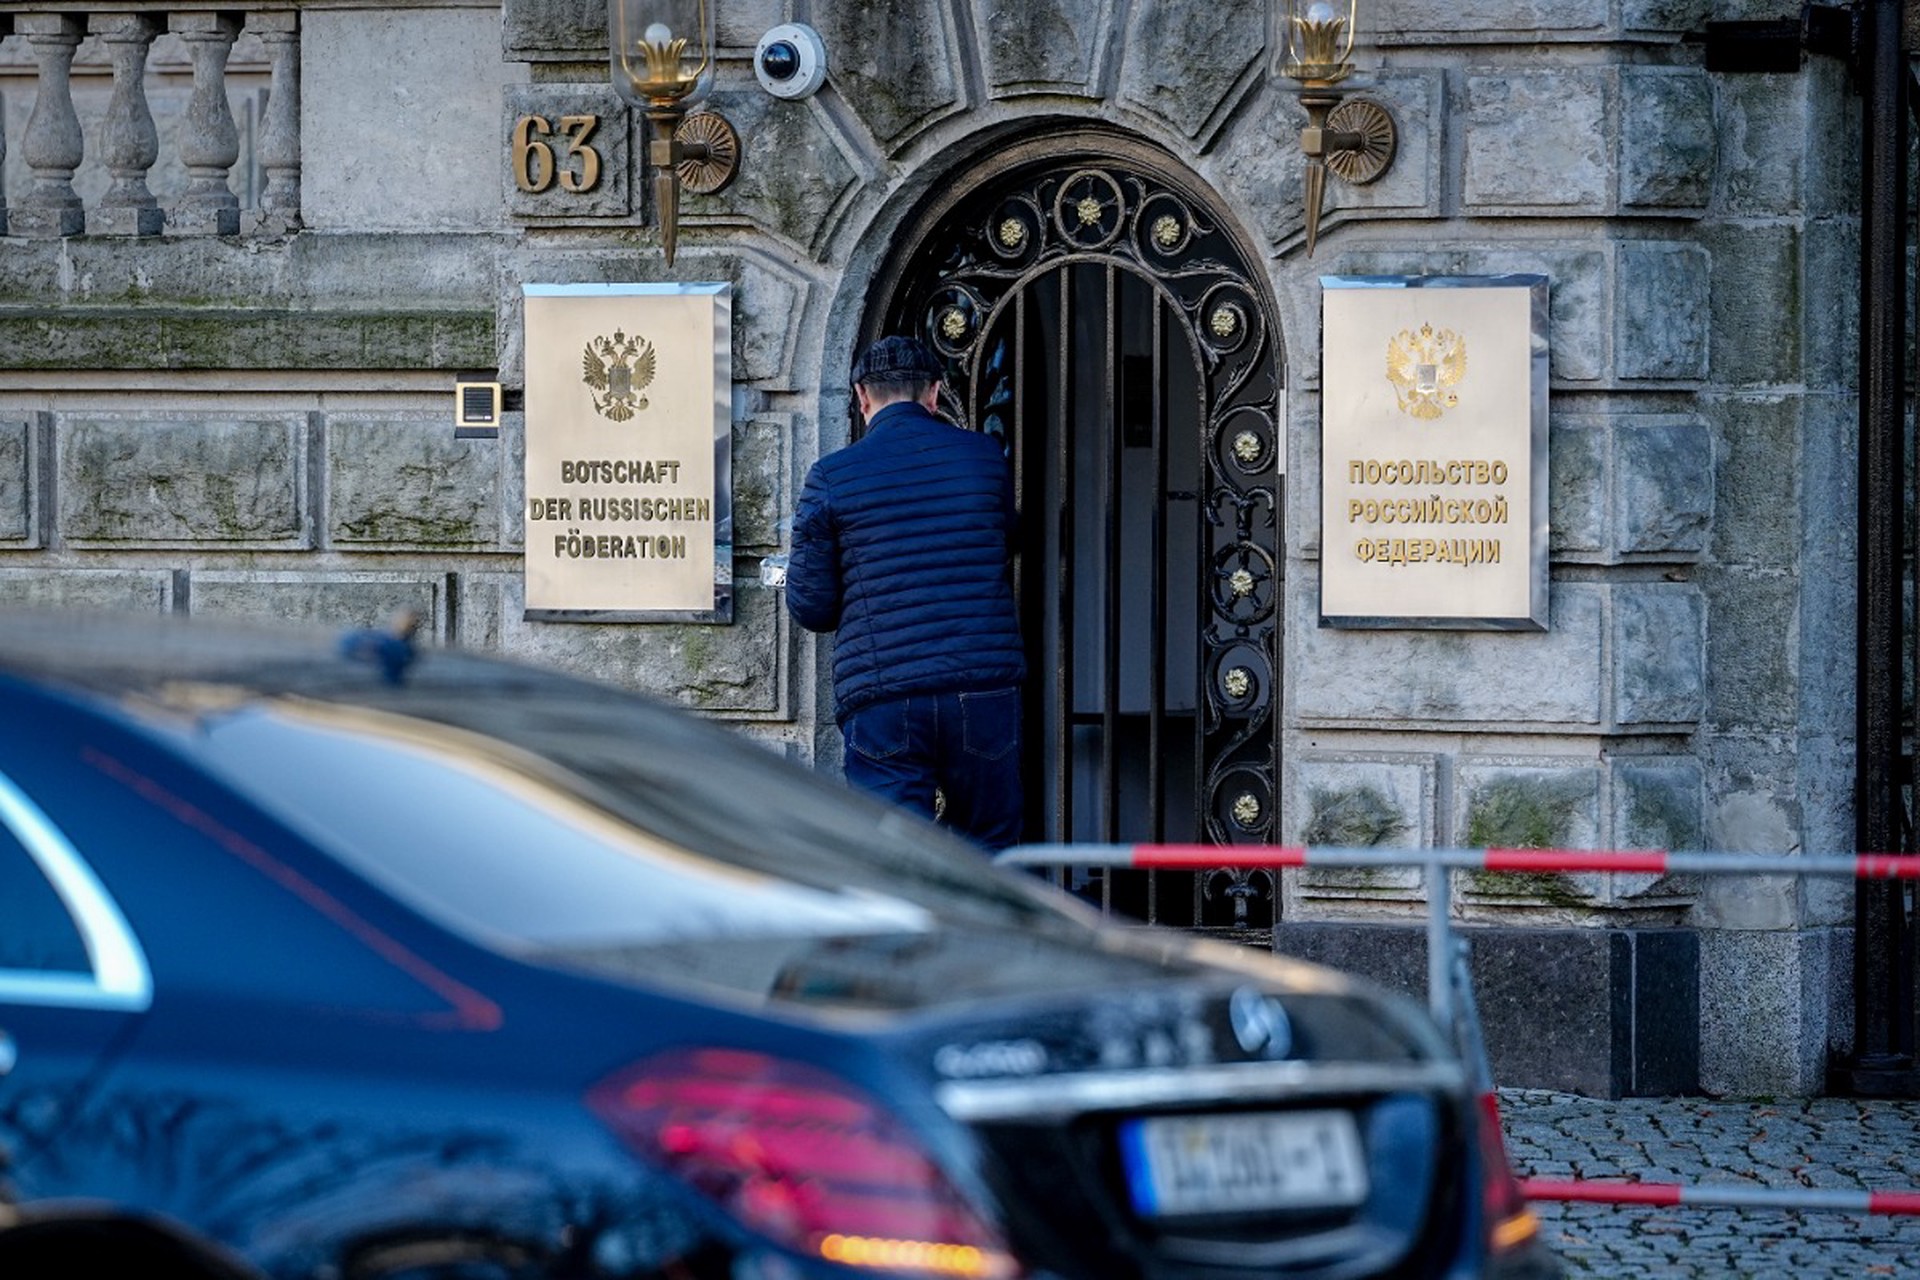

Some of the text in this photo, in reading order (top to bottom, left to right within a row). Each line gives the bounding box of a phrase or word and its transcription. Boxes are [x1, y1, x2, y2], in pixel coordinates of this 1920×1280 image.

[512, 115, 599, 192] 63
[561, 460, 680, 483] BOTSCHAFT
[1349, 460, 1508, 485] ПОСОЛЬСТВО
[529, 498, 710, 521] DER RUSSISCHEN
[1349, 495, 1508, 524] РОССИЙСКОЙ
[554, 528, 686, 559] FÖDERATION
[1355, 538, 1501, 567] ФЕДЕРАЦИИ
